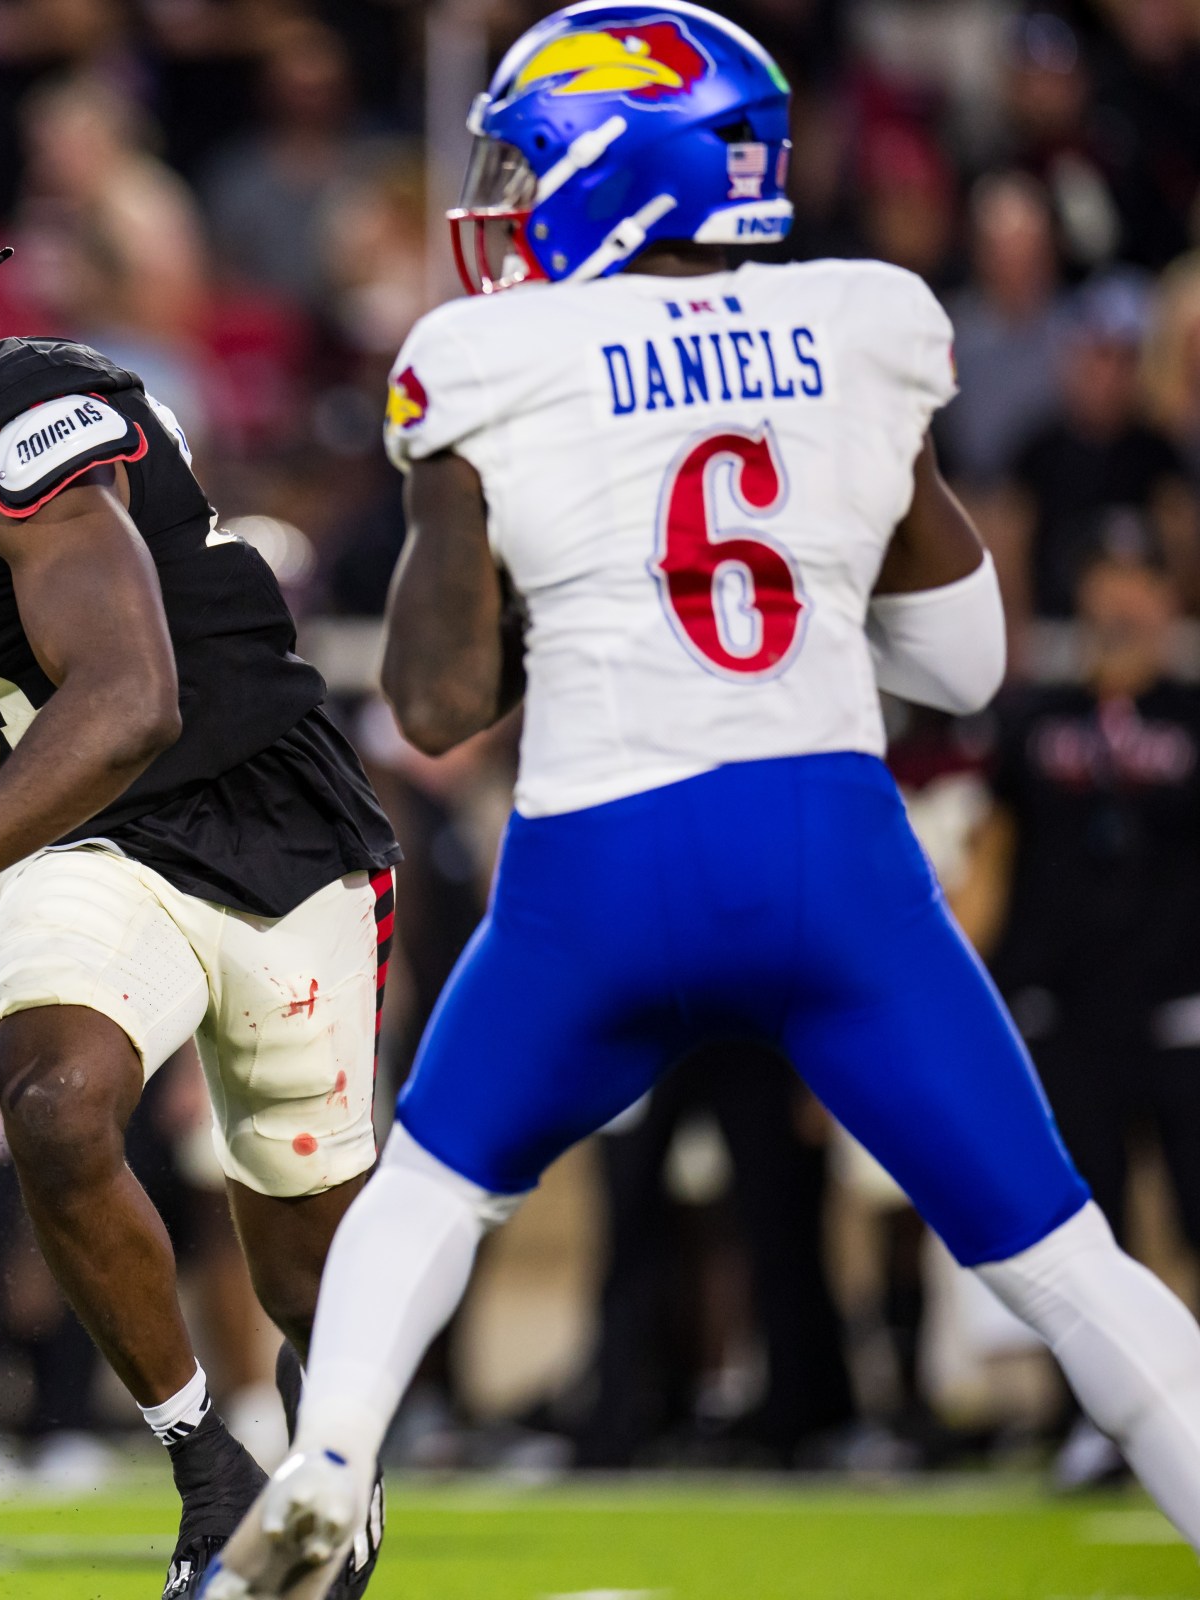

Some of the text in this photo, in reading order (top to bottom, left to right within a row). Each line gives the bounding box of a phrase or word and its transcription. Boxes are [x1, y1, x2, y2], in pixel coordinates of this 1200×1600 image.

[602, 327, 825, 416] DANIELS
[16, 401, 103, 465] DOUGLAS
[648, 419, 812, 684] 6
